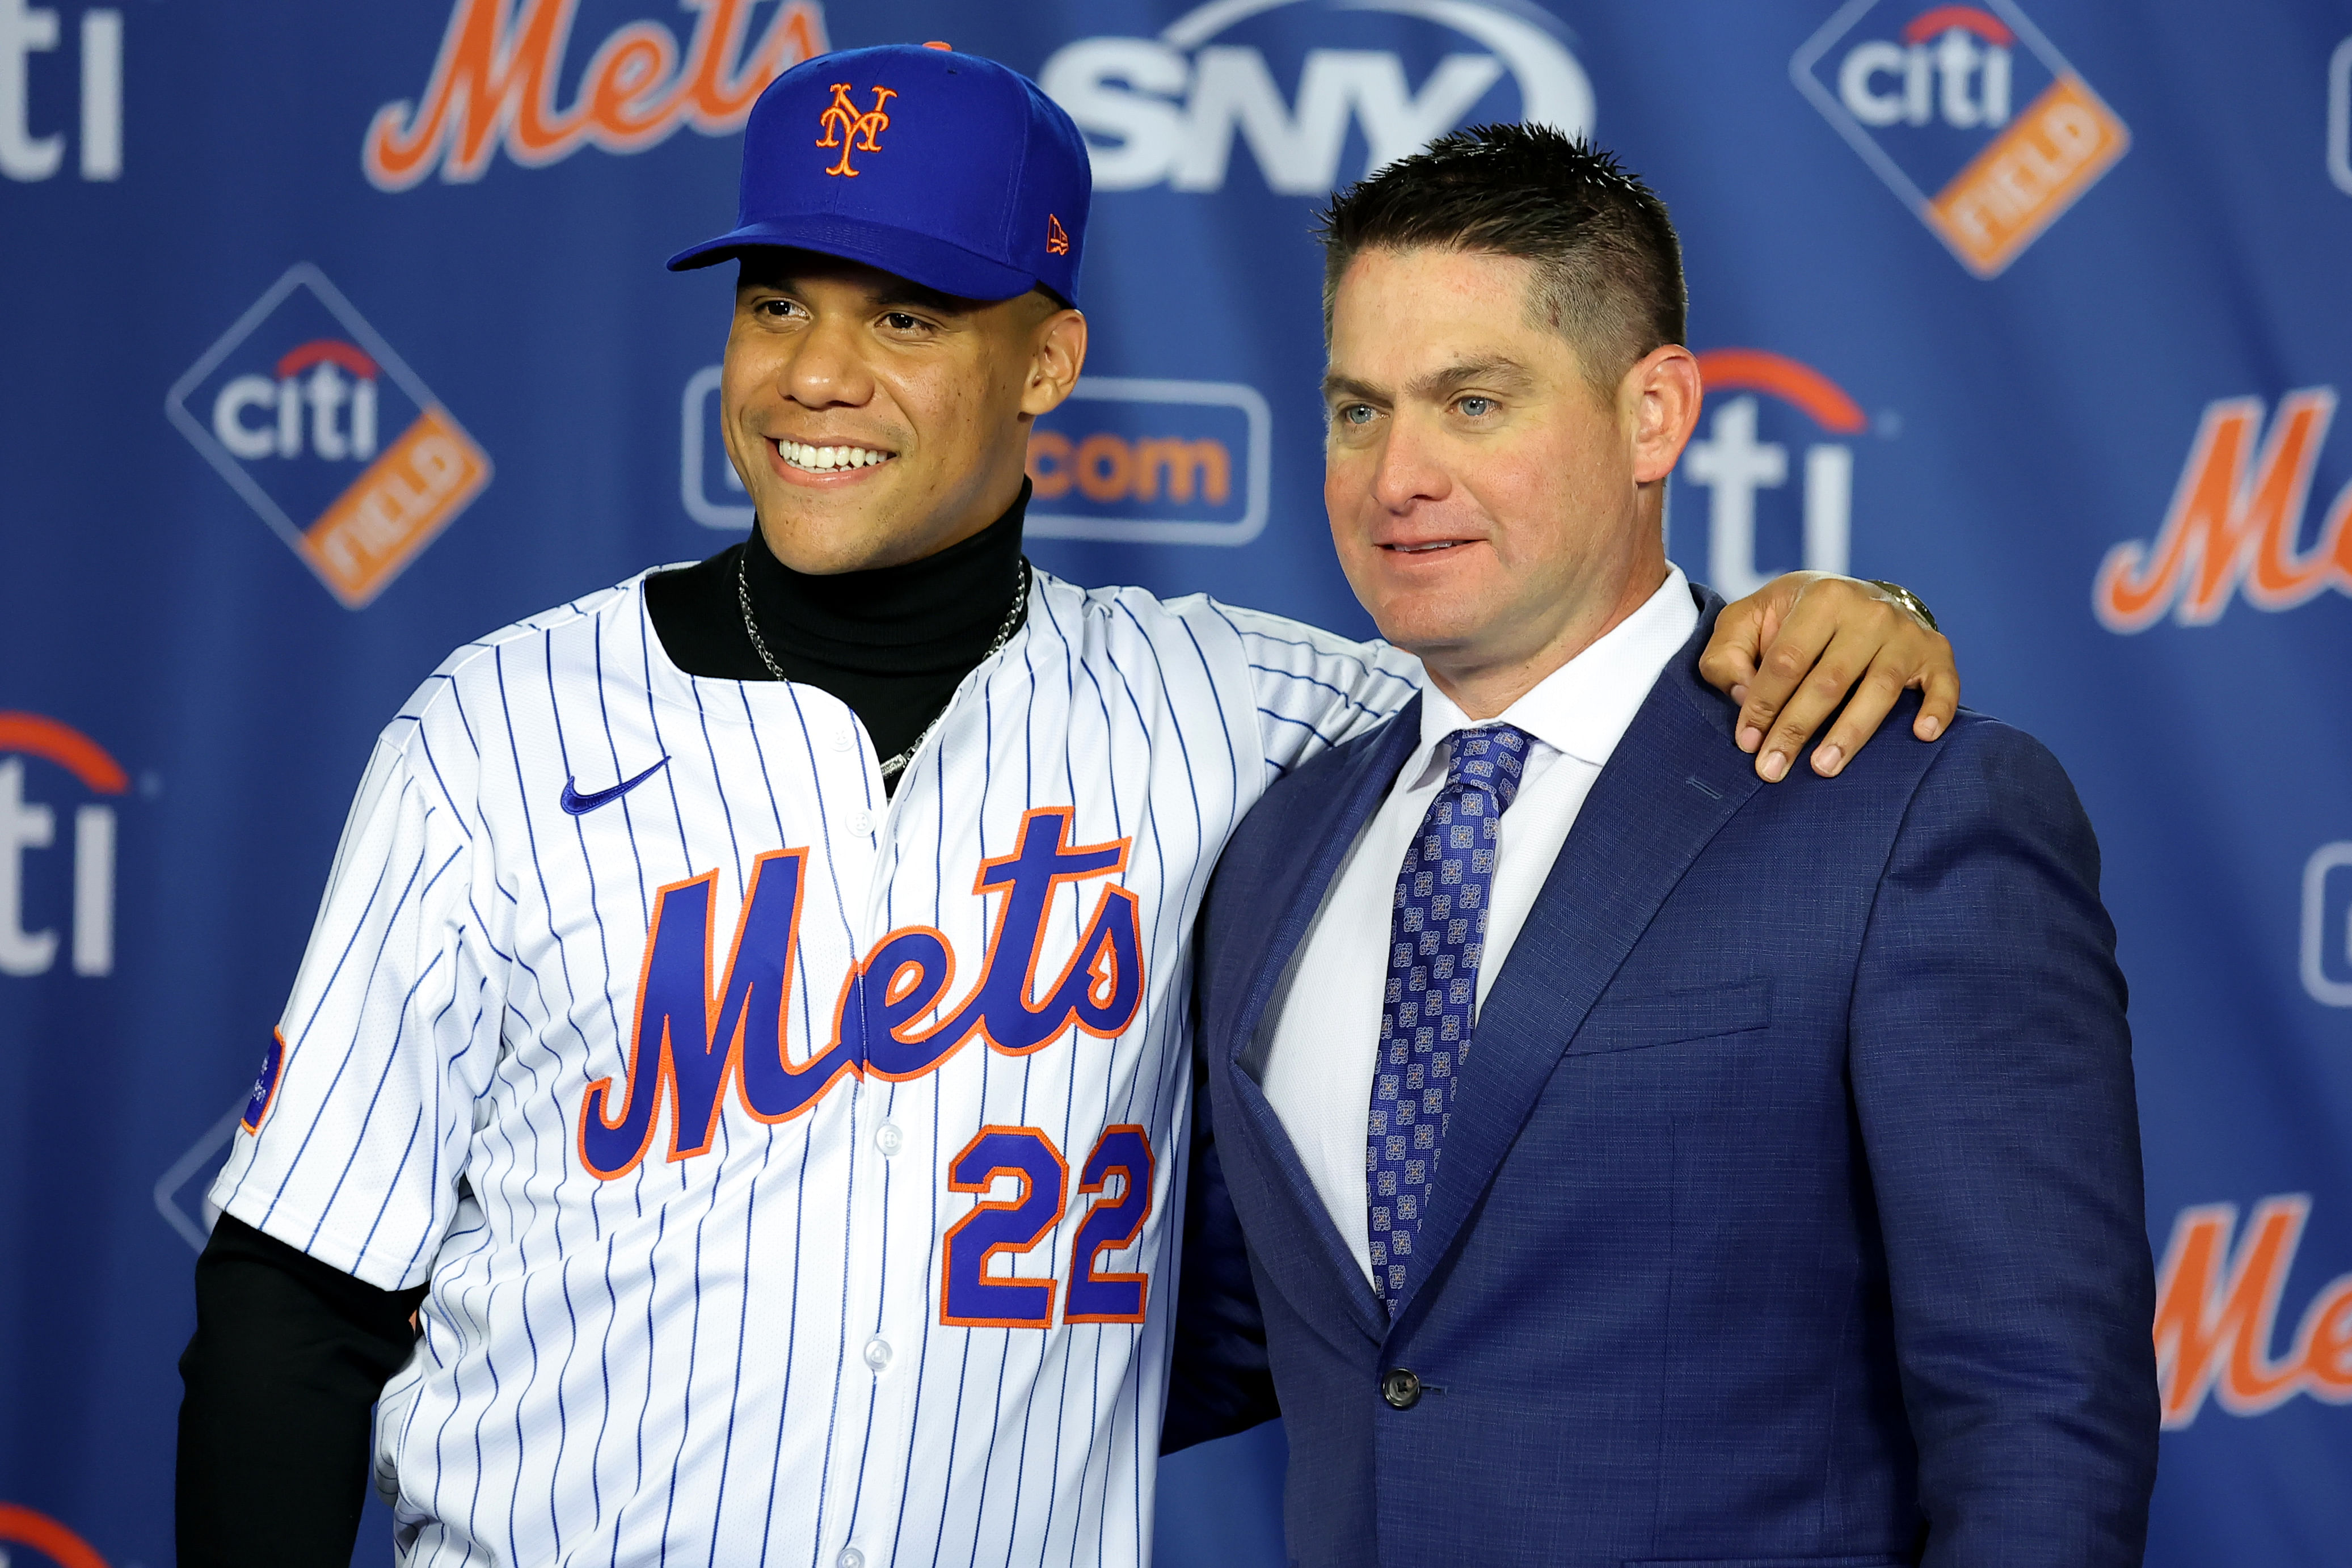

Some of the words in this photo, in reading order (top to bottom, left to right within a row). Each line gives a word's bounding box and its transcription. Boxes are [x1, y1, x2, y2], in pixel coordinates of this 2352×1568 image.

[1039, 35, 1506, 196] SNY
[1837, 26, 2014, 129] citi
[1948, 102, 2102, 248] FIELD
[212, 360, 379, 461] citi
[322, 435, 466, 578] FIELD
[577, 806, 1145, 1182] Mets
[939, 1124, 1155, 1329] 22
